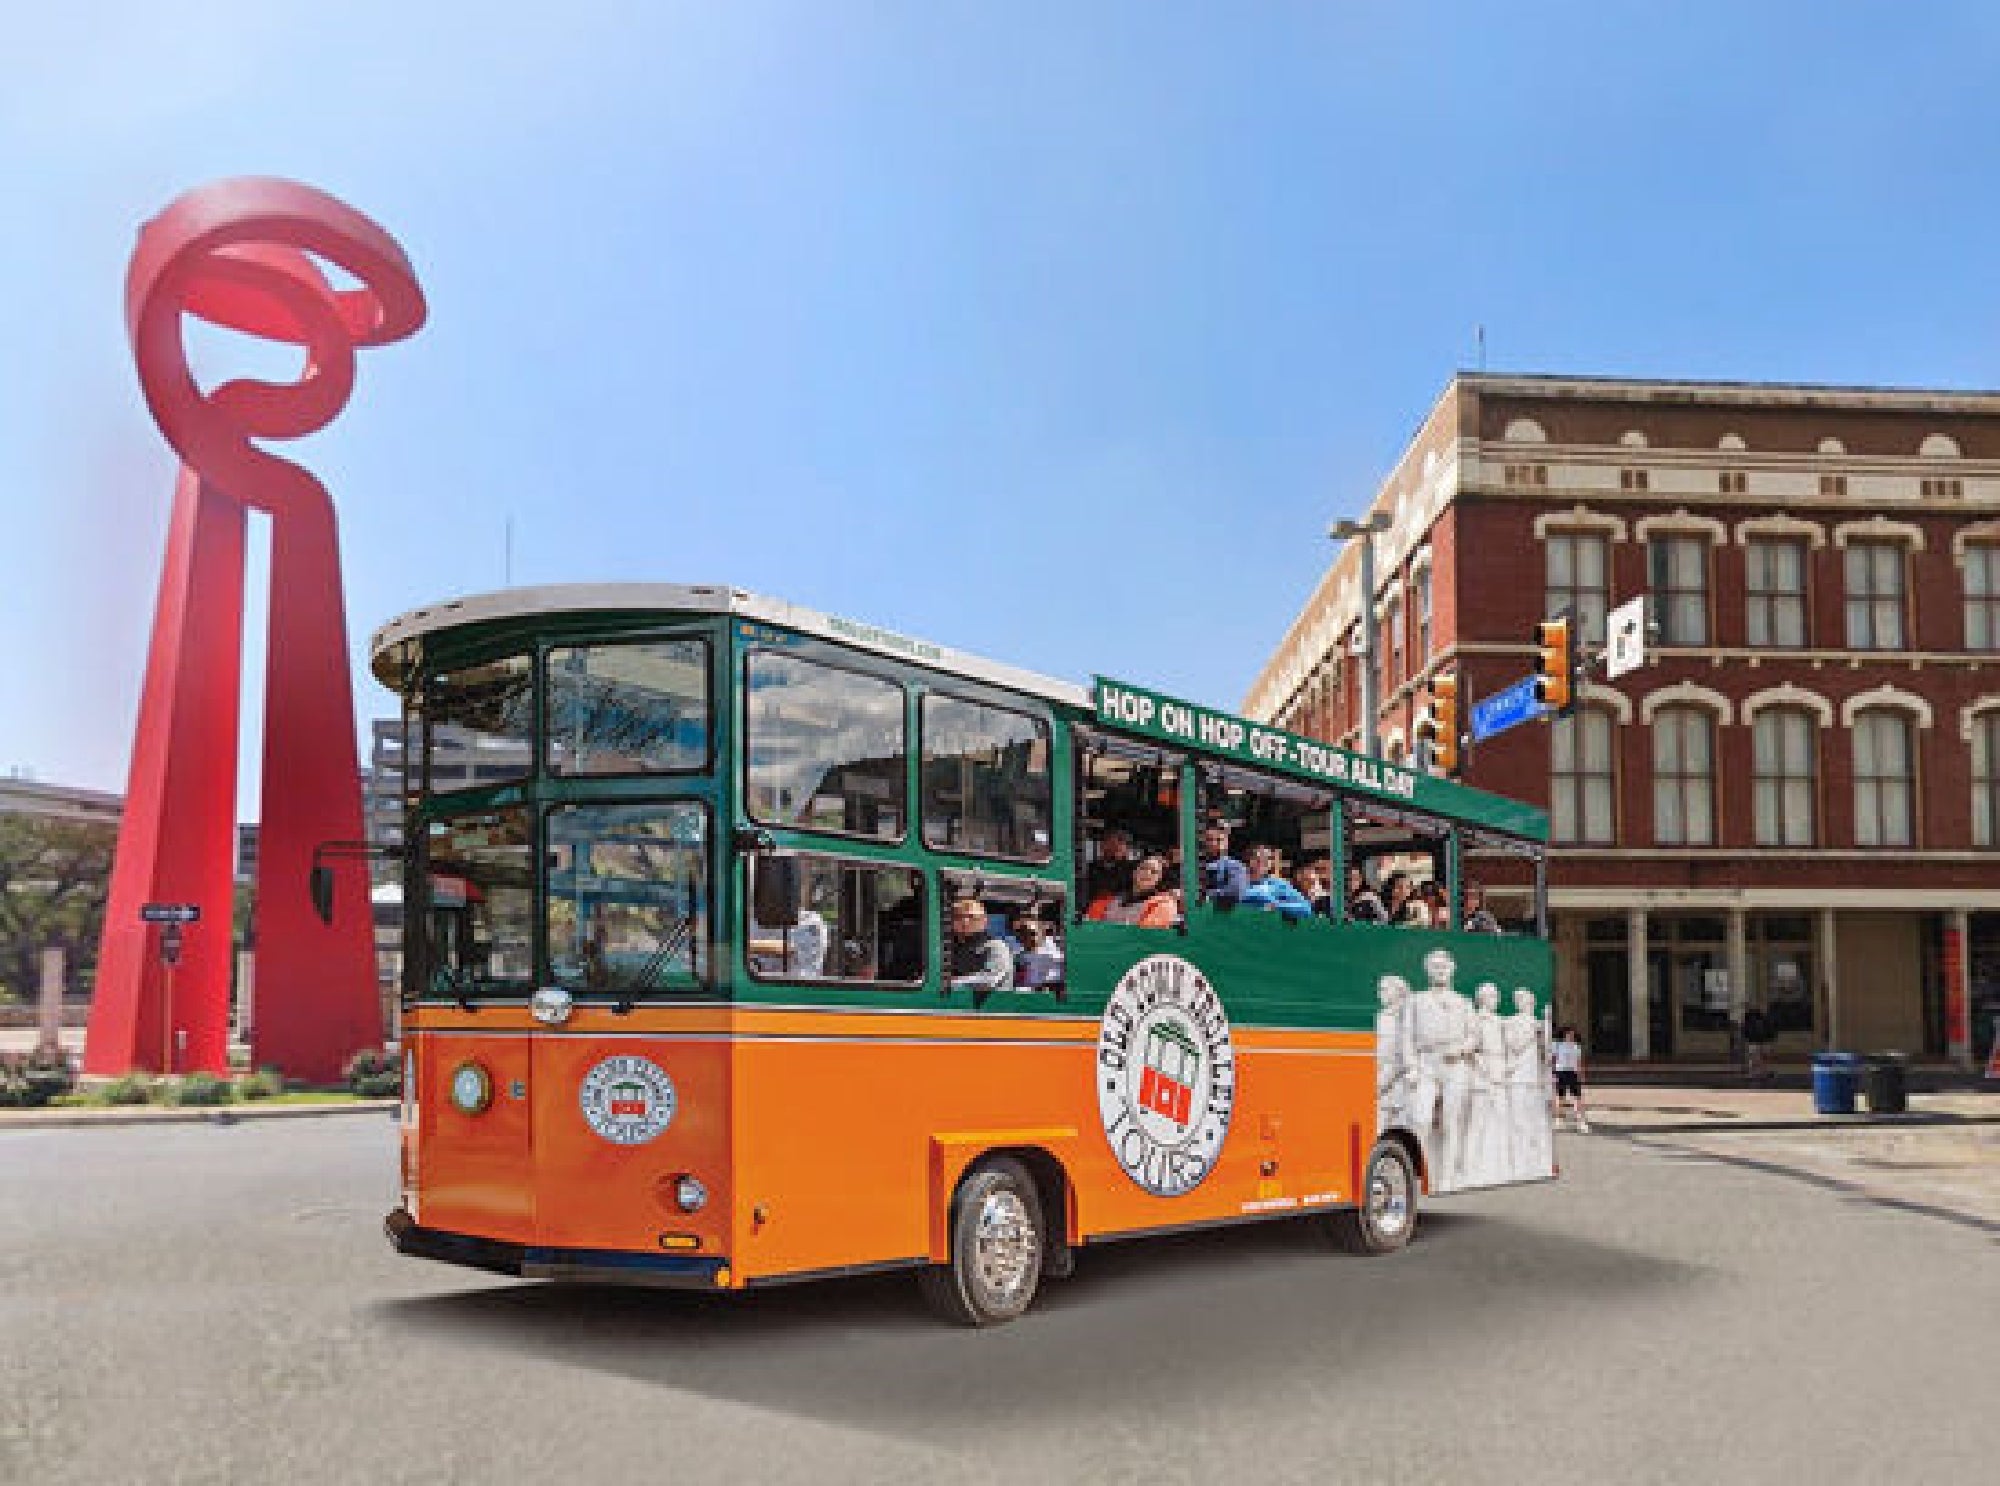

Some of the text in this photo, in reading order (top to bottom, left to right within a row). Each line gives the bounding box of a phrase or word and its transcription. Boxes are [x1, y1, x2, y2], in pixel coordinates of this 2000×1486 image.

[1103, 685, 1155, 725] HOP
[1161, 703, 1195, 738] ON
[1199, 713, 1245, 750] HOP
[1352, 758, 1382, 790] ALL
[1384, 767, 1414, 799] DAY
[1100, 1002, 1134, 1071] OLD
[1106, 1094, 1209, 1194] TOURS
